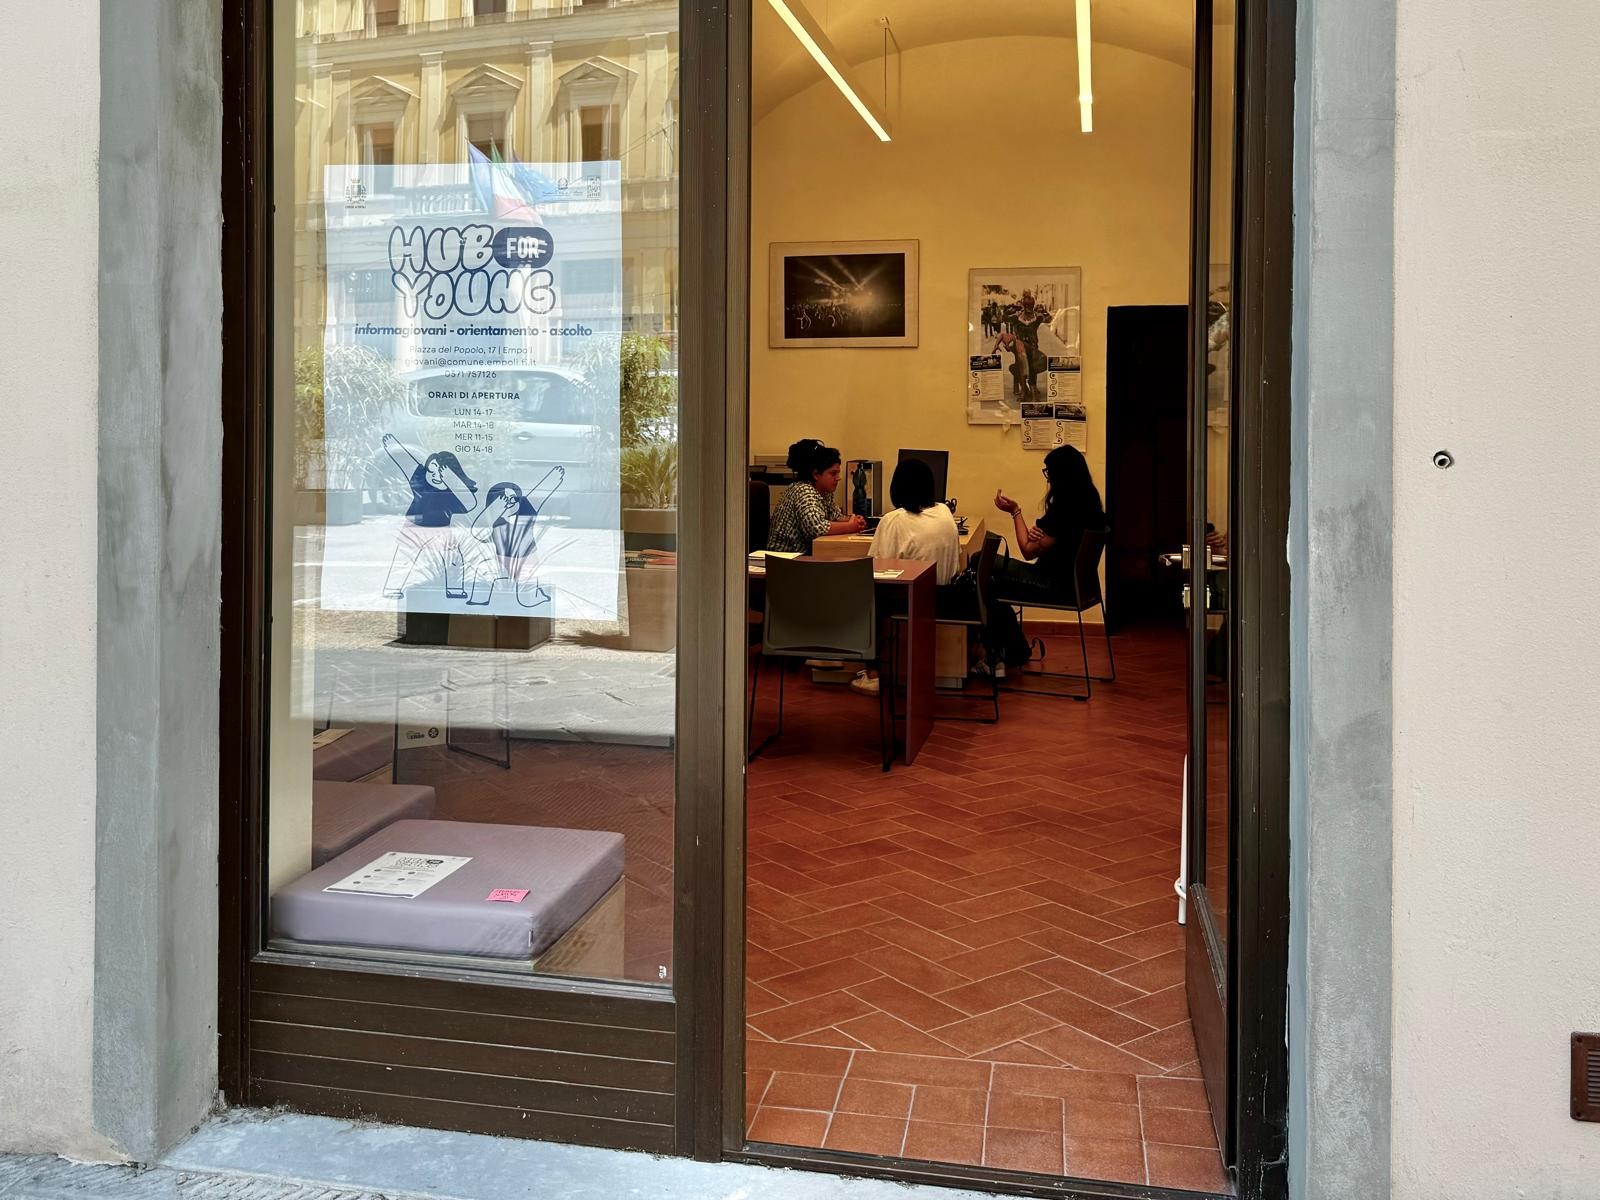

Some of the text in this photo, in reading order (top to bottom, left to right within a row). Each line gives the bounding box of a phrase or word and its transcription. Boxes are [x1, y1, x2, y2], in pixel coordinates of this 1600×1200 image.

[389, 224, 539, 273] HUB FOR
[392, 268, 556, 320] YOUNG
[354, 323, 447, 338] informagiovani
[457, 323, 539, 336] orientamento
[549, 324, 593, 337] ascolto
[409, 345, 437, 354] Piazza
[438, 345, 452, 354] del
[454, 346, 486, 355] Popolo,
[488, 346, 497, 354] 17
[467, 370, 497, 379] 757126
[428, 391, 456, 399] ORARI
[471, 392, 520, 400] APERTURA
[454, 408, 471, 416] LUN
[453, 421, 494, 429] MAR 14-18
[455, 433, 493, 441] MER 11-15
[455, 445, 493, 453] GIO 14-18
